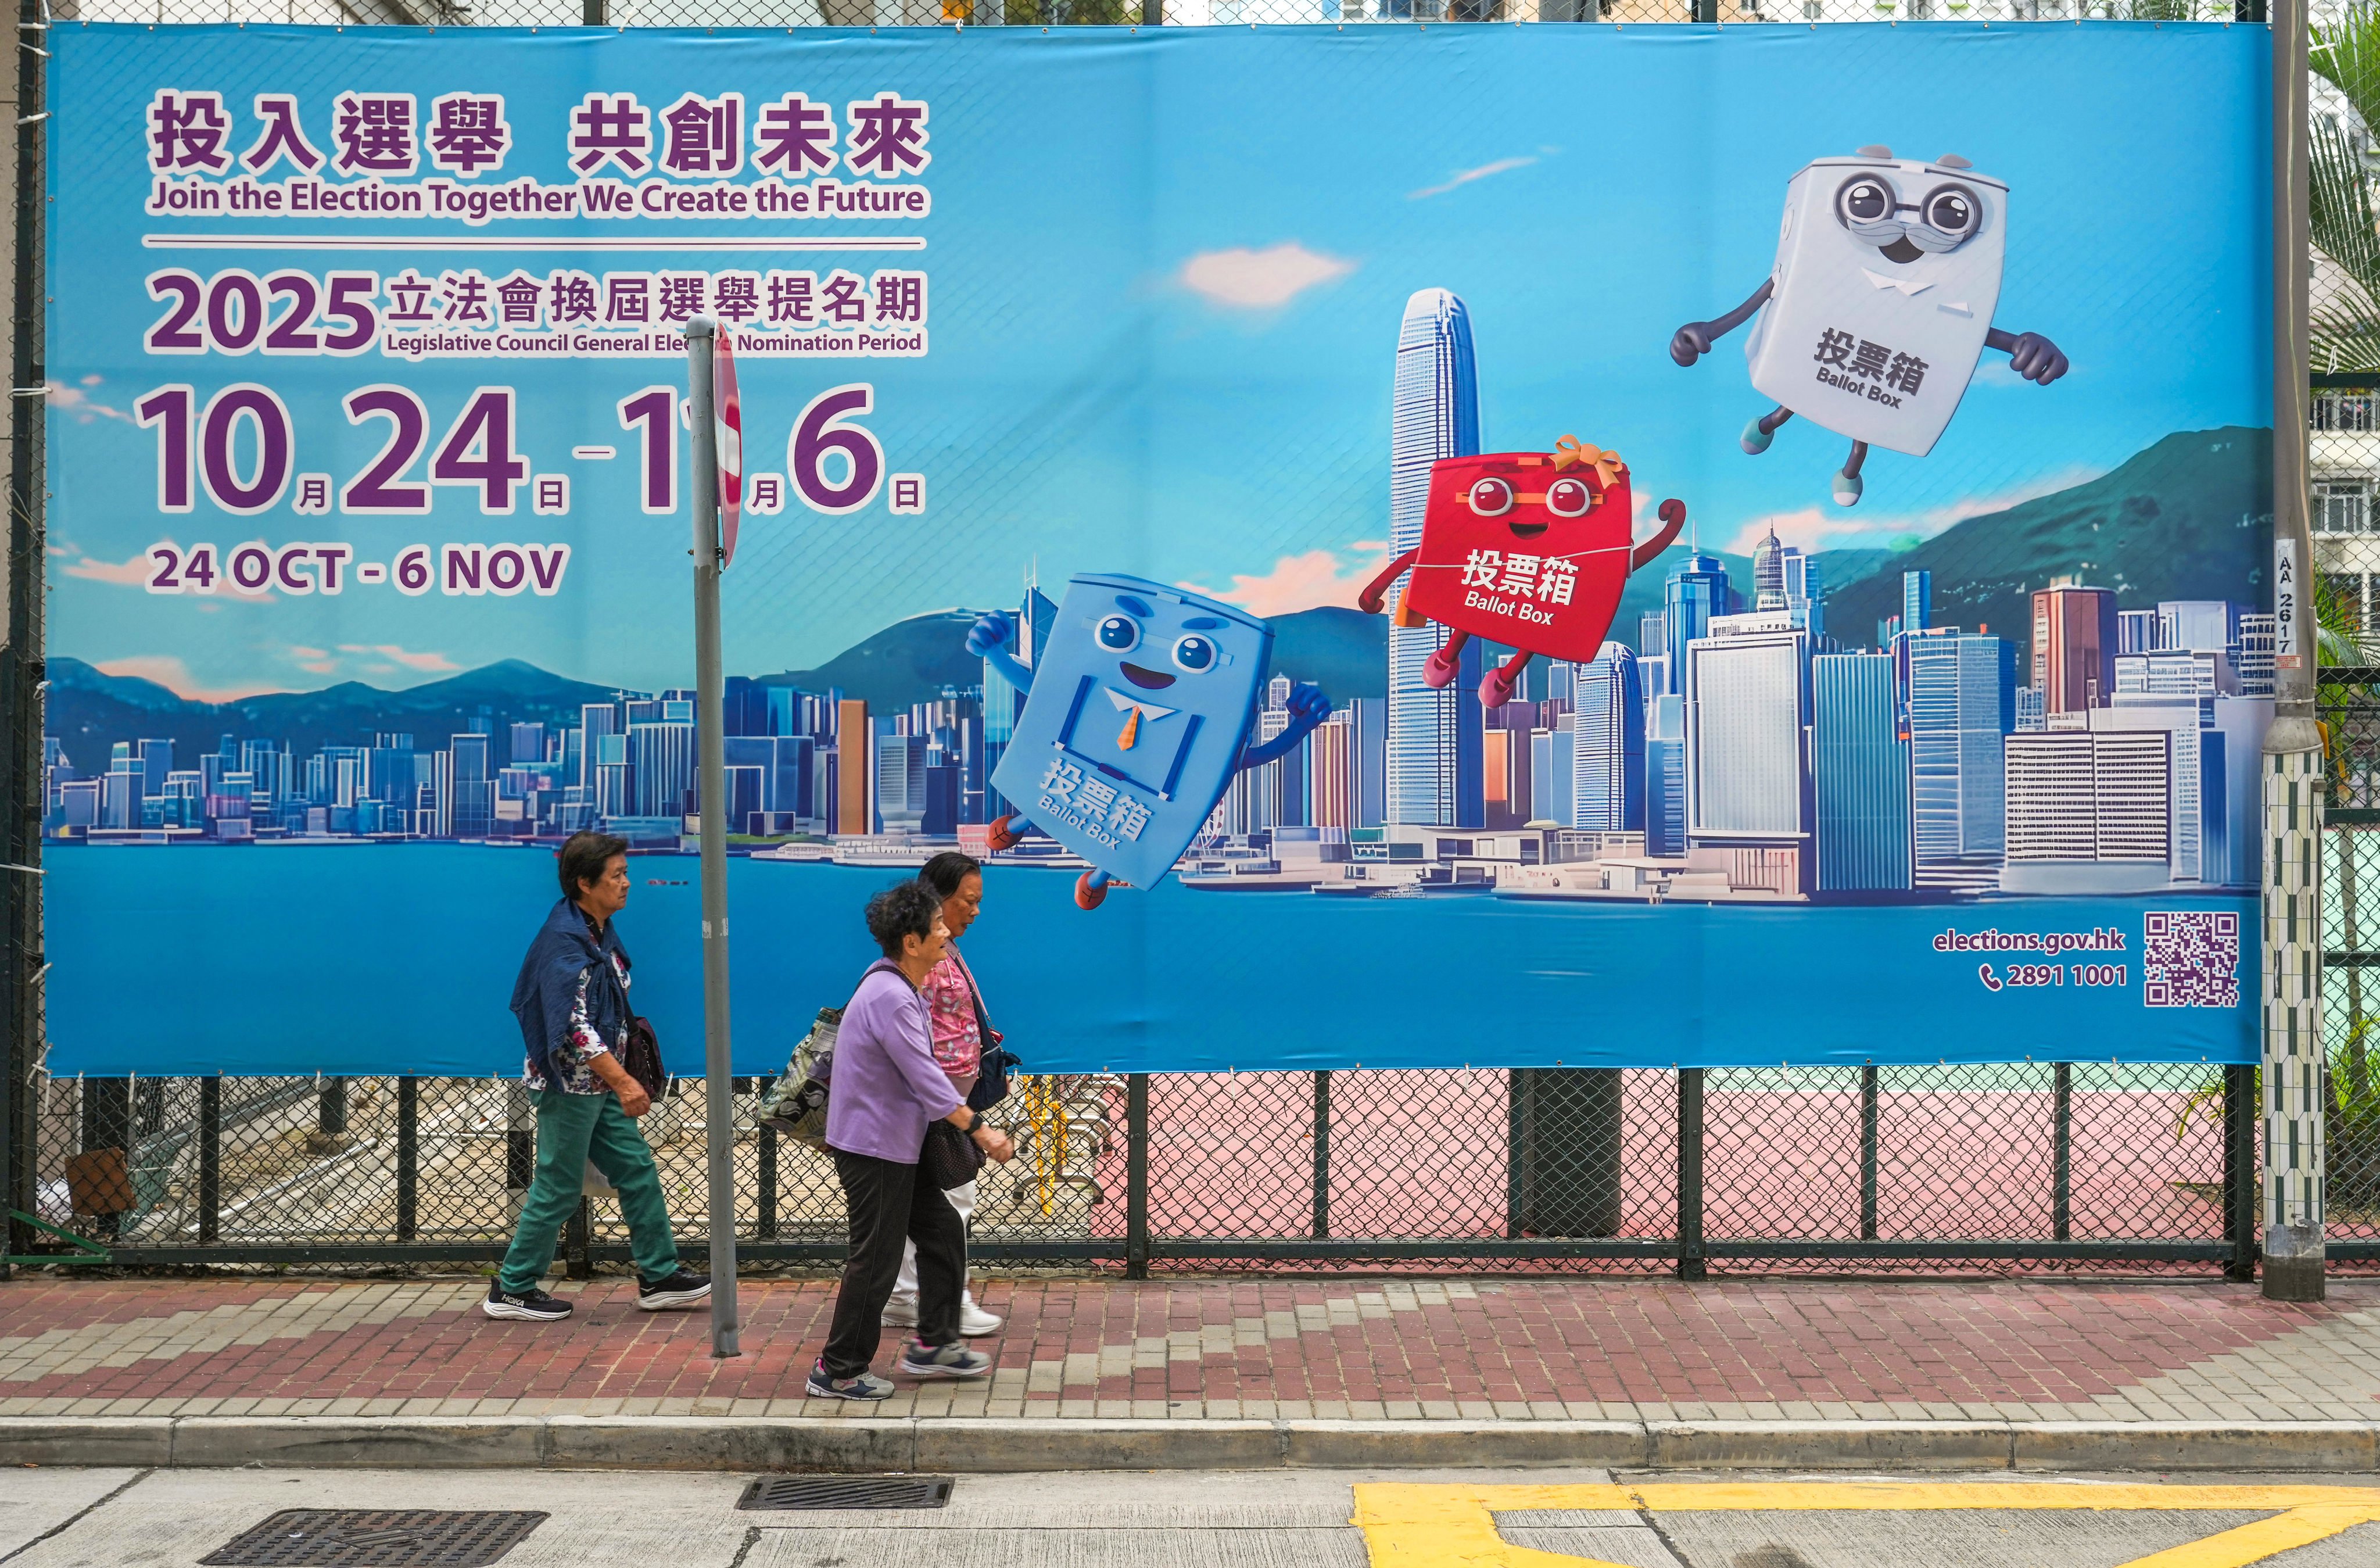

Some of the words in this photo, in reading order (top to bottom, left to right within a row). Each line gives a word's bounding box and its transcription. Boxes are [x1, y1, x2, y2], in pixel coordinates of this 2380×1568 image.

[153, 96, 504, 171] 投入選舉
[575, 99, 923, 171] 共創未來
[153, 182, 219, 209] Join
[228, 182, 282, 210] the
[291, 182, 421, 210] Election
[428, 184, 577, 219] Together
[583, 185, 633, 212] We
[641, 185, 747, 212] Create
[755, 184, 808, 212] the
[818, 185, 924, 212] Future
[151, 275, 375, 349] 2025
[388, 335, 492, 355] Legislative
[497, 334, 568, 350] Council
[574, 334, 649, 350] General
[738, 334, 853, 350] Nomination
[859, 334, 921, 350] Period
[1813, 327, 1929, 396] 投票箱
[1816, 366, 1865, 396] Ballot
[1867, 385, 1902, 409] Box
[152, 550, 214, 587] 24
[233, 549, 346, 588] OCT
[399, 551, 427, 588] 6
[449, 550, 564, 589] NOV
[1461, 549, 1579, 606] 投票箱
[1464, 590, 1516, 617] Ballot
[1518, 603, 1554, 625] Box
[1040, 757, 1153, 842] 投票箱
[1038, 794, 1088, 831] Ballot
[1086, 822, 1121, 850] Box
[1934, 929, 2125, 955] elections.gov.hk
[2008, 966, 2062, 985] 2891
[2073, 966, 2125, 985] 1001
[501, 1294, 525, 1307] HOKA
